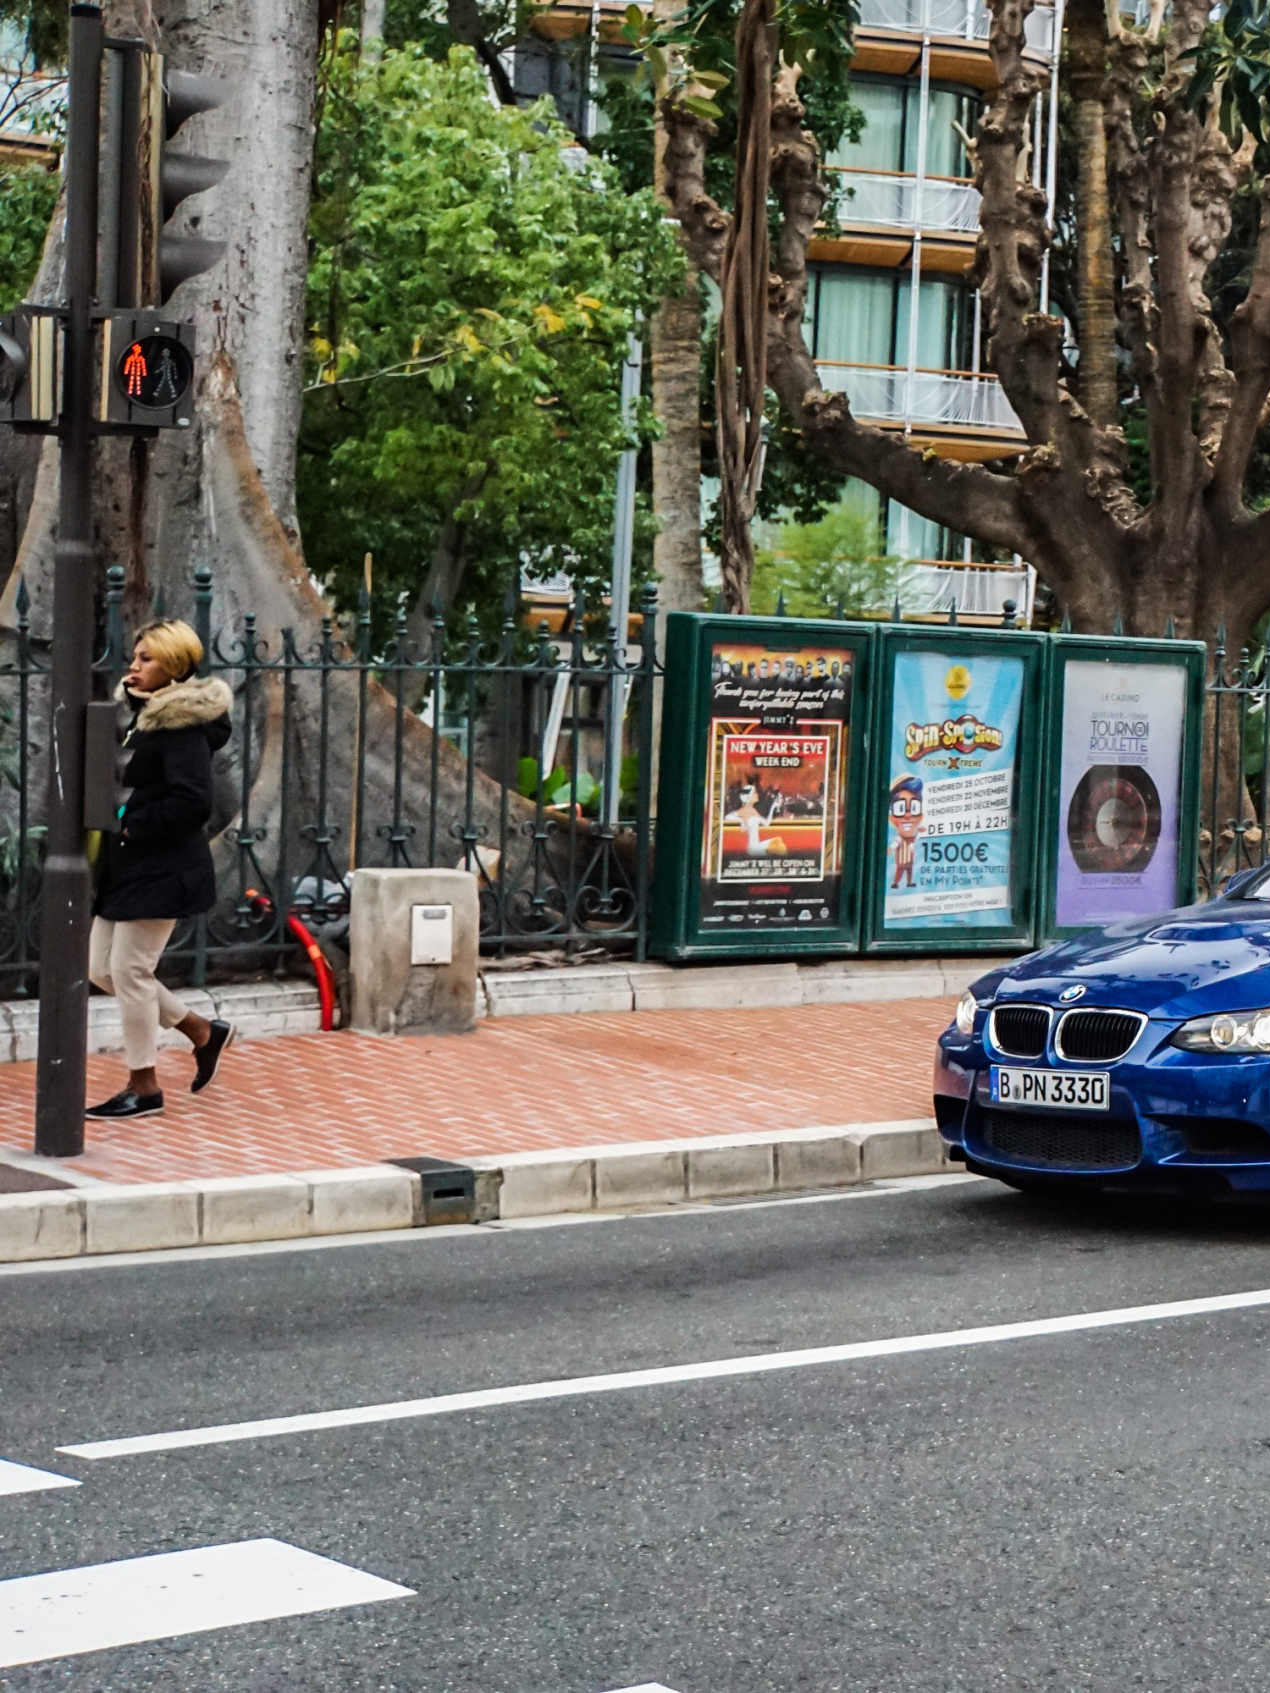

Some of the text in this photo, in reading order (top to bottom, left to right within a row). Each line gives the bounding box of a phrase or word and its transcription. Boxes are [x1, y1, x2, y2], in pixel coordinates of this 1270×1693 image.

[714, 681, 742, 698] Thank
[742, 689, 759, 699] you
[758, 688, 775, 700] for
[800, 689, 823, 700] part
[822, 689, 831, 701] of
[830, 689, 845, 700] this
[1101, 693, 1140, 703] LE CASINO
[738, 698, 795, 711] unforgettable
[1090, 720, 1149, 738] TOURNOI
[730, 741, 824, 755] NEW YEAR'S EVE
[1090, 737, 1149, 752] ROULETTE
[755, 756, 801, 767] WEEK END
[927, 773, 1006, 794] VENDREDI 25 OCTOBRE
[927, 785, 1009, 805] VENDREDI 22 NOVEMBRE
[927, 797, 1008, 816] VENDREDI 20 DÉCEMBRE
[928, 815, 1008, 835] DE 19H À 22H
[921, 842, 989, 863] 1500€
[782, 859, 804, 868] OPEN
[803, 859, 816, 867] ON
[920, 866, 932, 874] DE
[934, 865, 968, 874] PARTIES
[920, 877, 932, 886] EN
[924, 894, 963, 903] INSCRIPTION
[1000, 1072, 1105, 1104] B PN 3330
